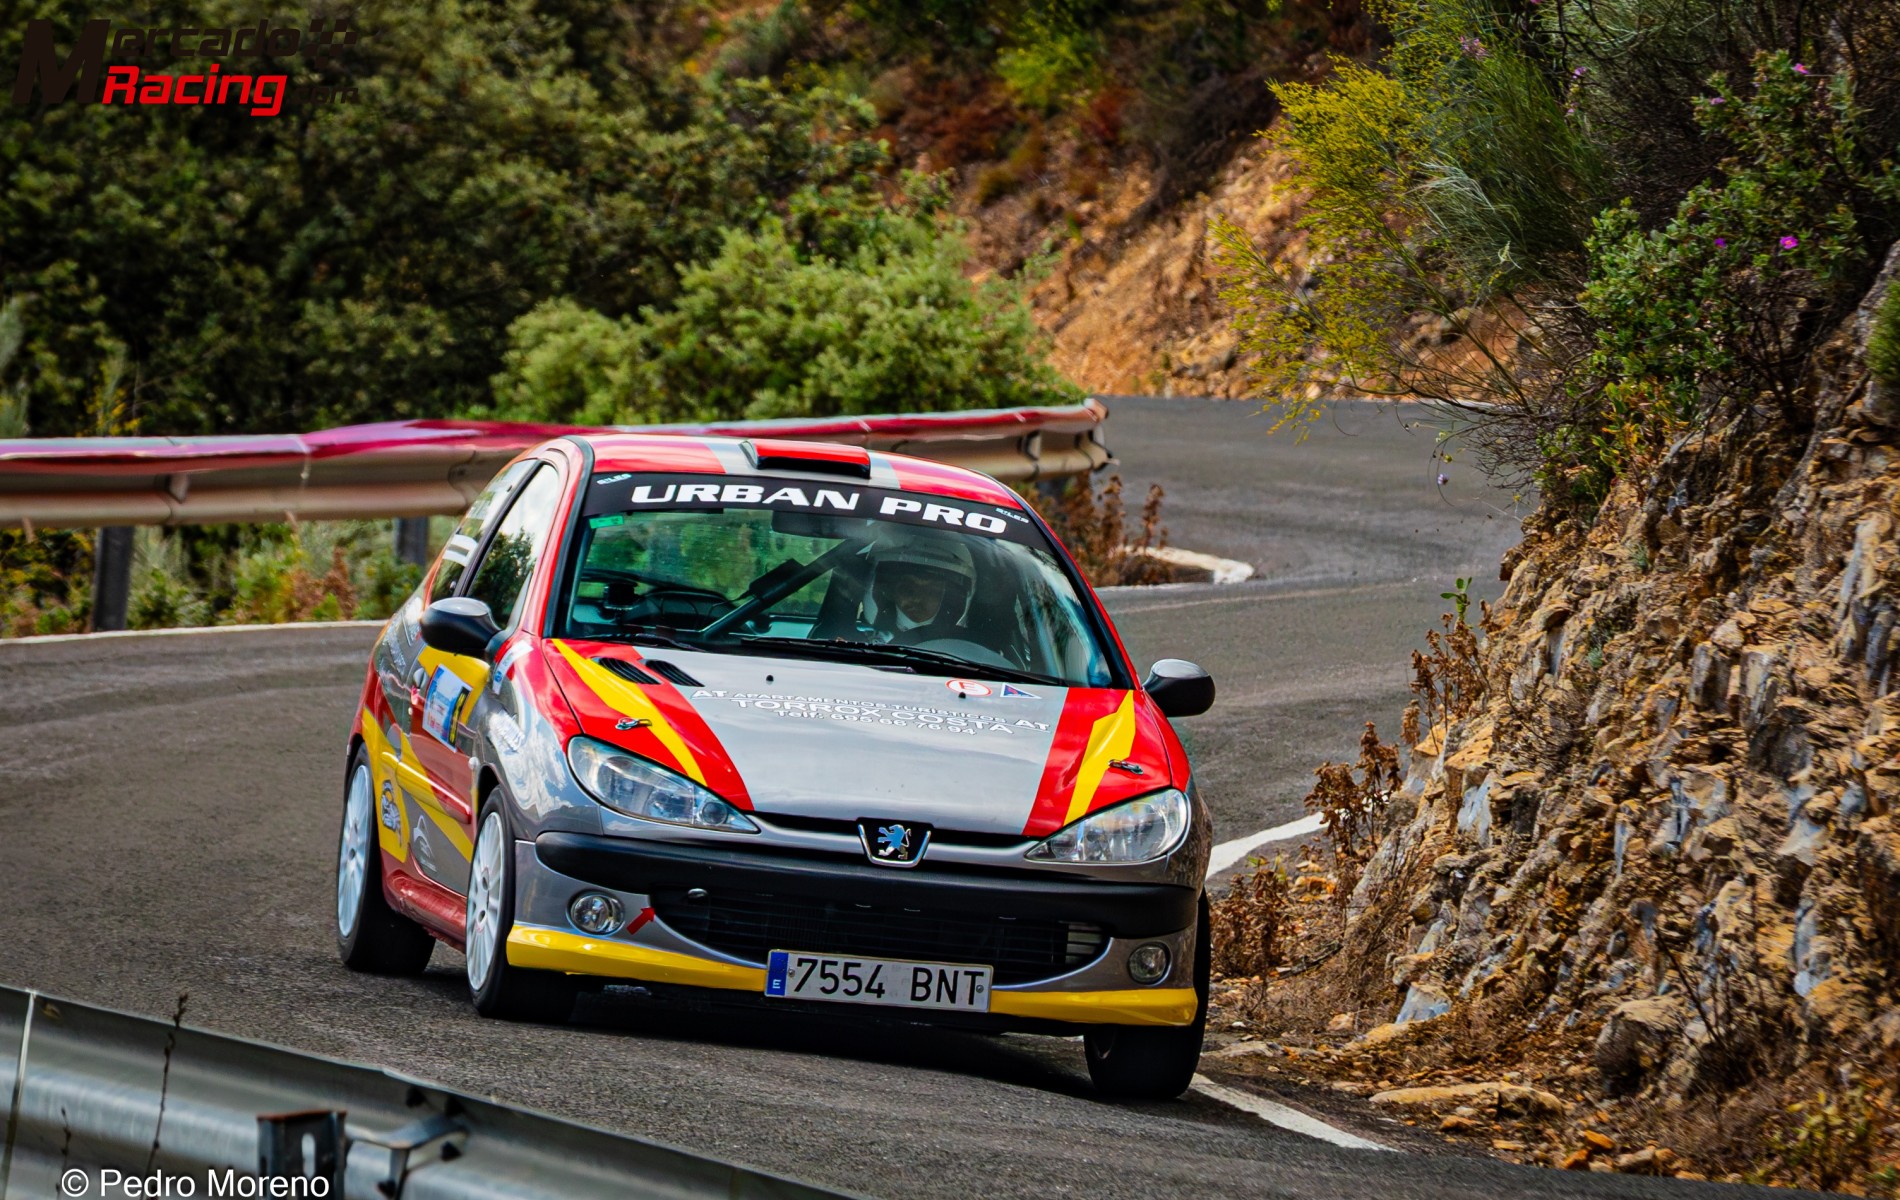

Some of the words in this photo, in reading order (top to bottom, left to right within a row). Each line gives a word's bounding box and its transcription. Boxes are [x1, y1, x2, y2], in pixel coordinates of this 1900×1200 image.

[631, 484, 860, 511] URBAN
[879, 496, 1007, 534] PRO
[692, 689, 729, 699] AT
[734, 692, 887, 709] APARTAMENTOS
[1014, 718, 1051, 731] AT
[731, 698, 882, 718] TORROX
[891, 711, 1015, 734] COSTA
[772, 978, 782, 989] E
[794, 957, 886, 998] 7554
[910, 967, 985, 1006] BNT
